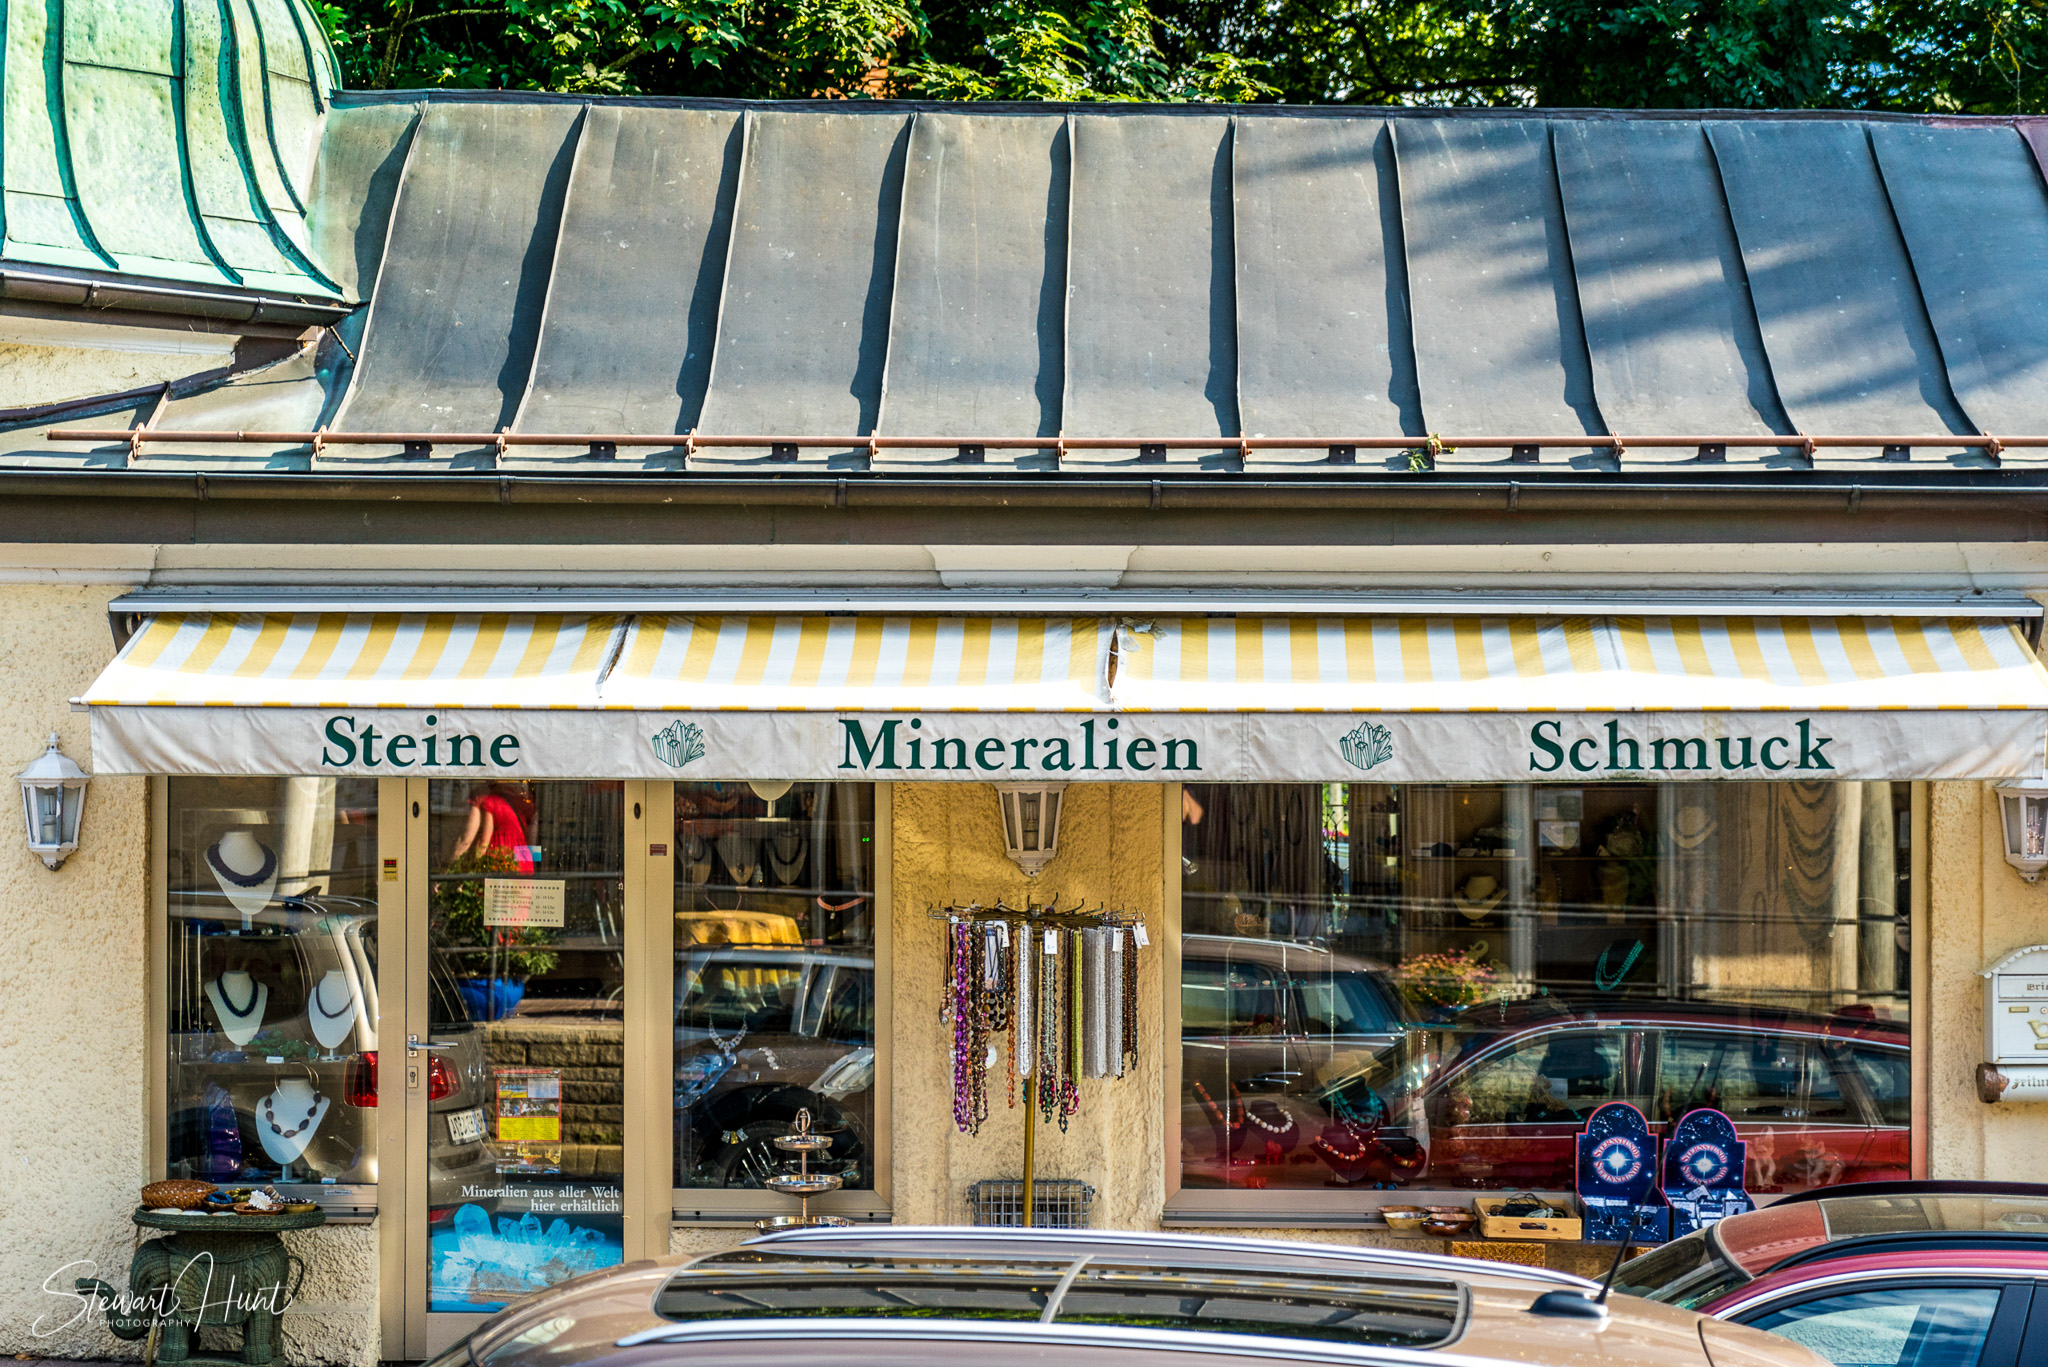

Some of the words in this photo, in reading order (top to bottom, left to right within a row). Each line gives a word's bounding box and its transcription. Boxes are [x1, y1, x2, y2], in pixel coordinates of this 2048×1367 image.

[321, 714, 521, 768] Steine
[837, 717, 1203, 772] Mineralien
[1529, 718, 1836, 773] Schmuck
[461, 1185, 528, 1198] Mineralien
[533, 1188, 554, 1198] aus
[558, 1186, 586, 1198] aller
[591, 1186, 619, 1198] Welt
[530, 1199, 556, 1211] hier
[560, 1199, 619, 1212] erhältlich
